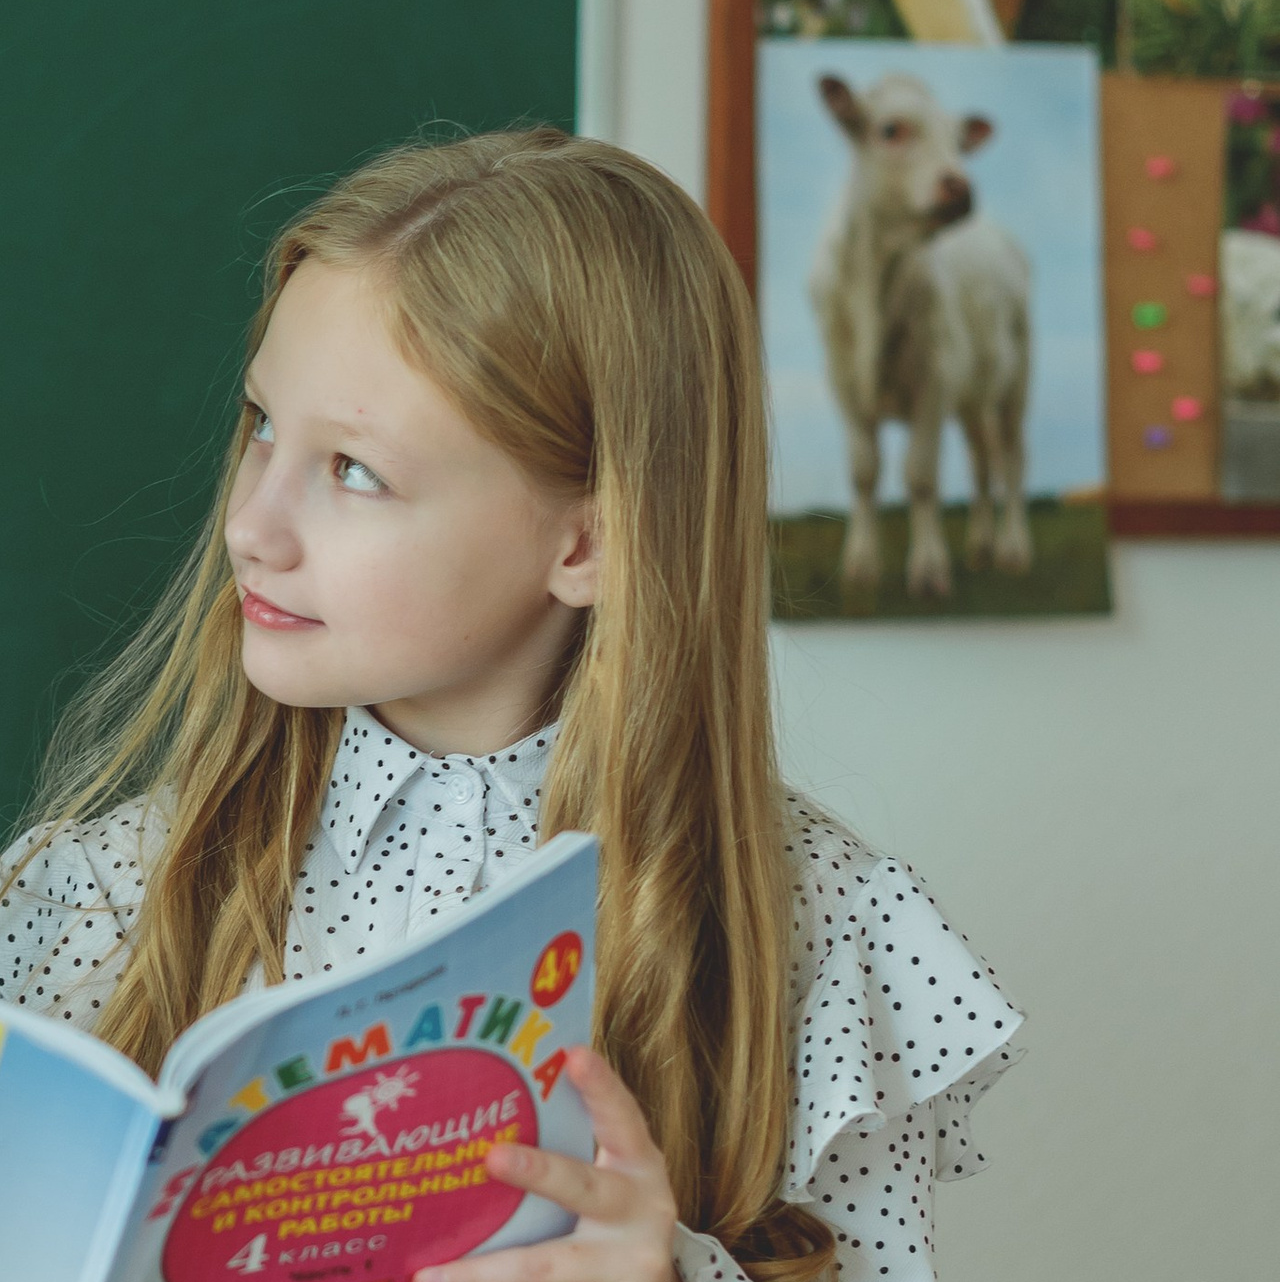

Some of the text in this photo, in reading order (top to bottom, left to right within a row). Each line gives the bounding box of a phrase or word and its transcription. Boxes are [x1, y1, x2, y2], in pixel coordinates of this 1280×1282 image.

[200, 1089, 522, 1195] РАЗВИВАЮЩИЕ
[212, 1163, 488, 1233] И КОНТРОЛЬНЫЕ
[277, 1203, 414, 1240] РАБОТЫ
[225, 1232, 388, 1276] 4 класс
